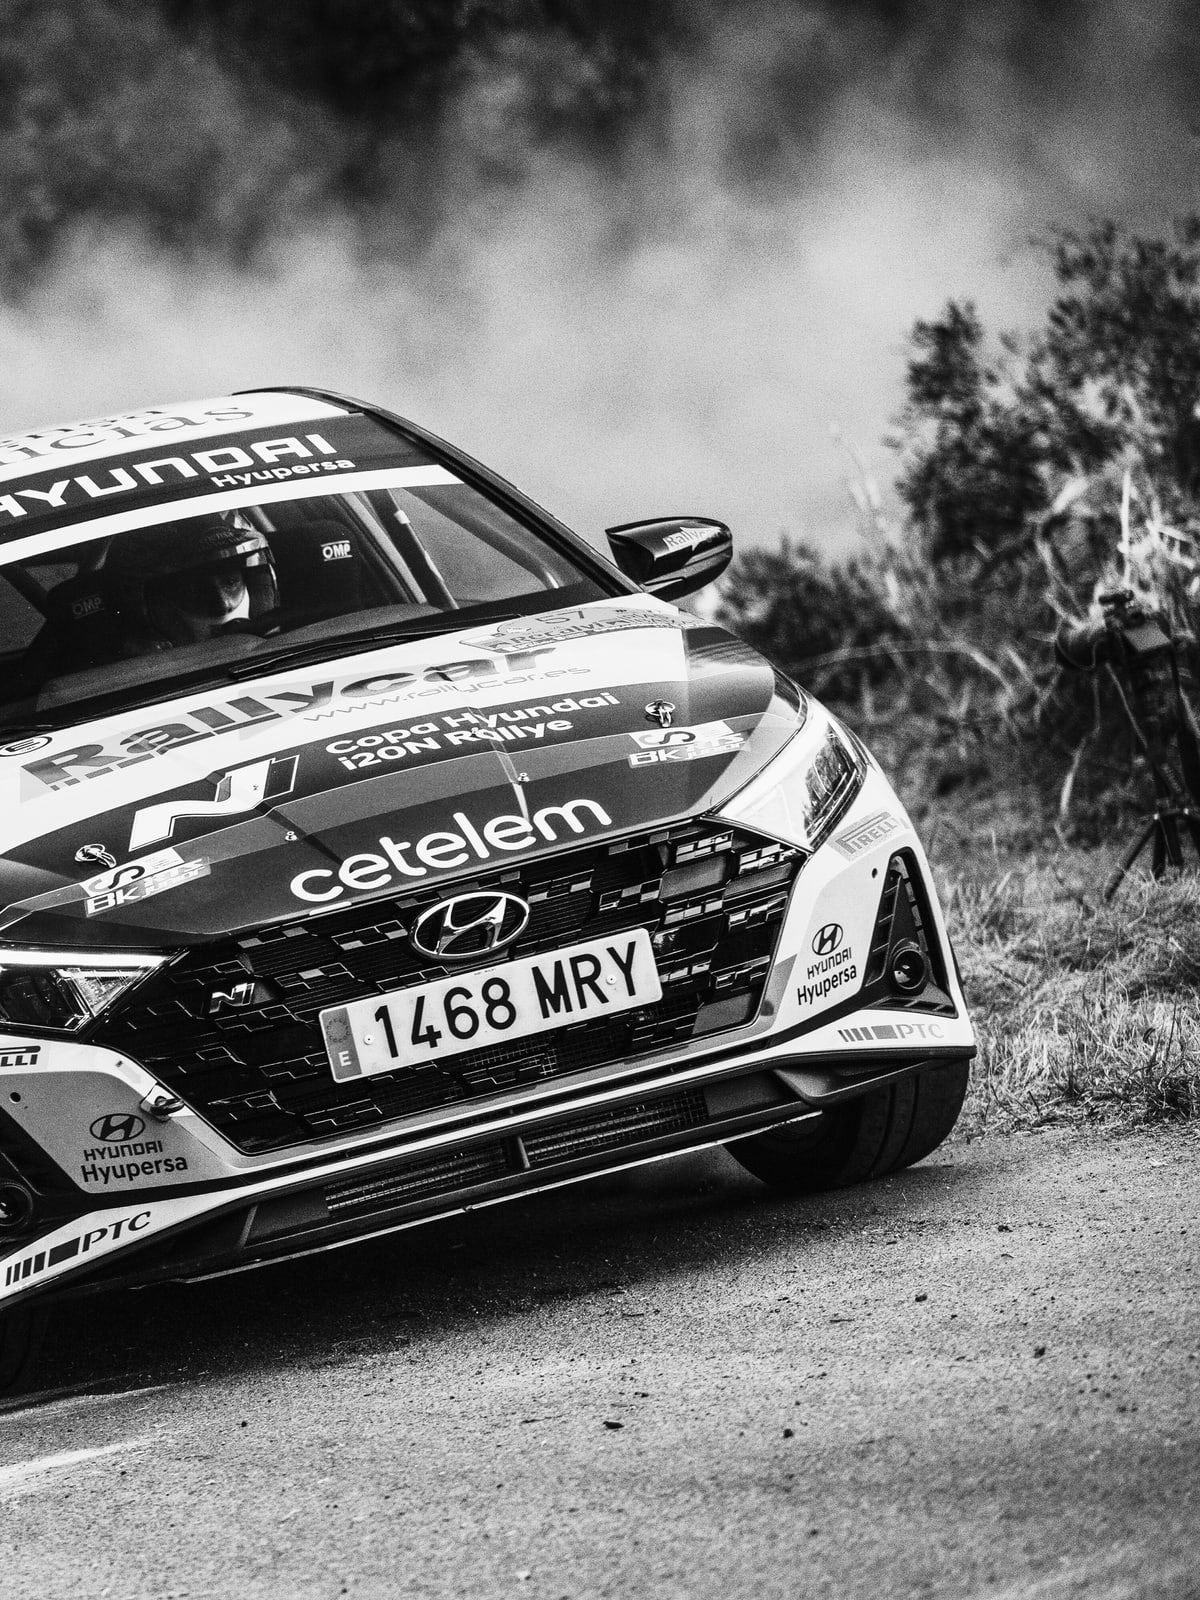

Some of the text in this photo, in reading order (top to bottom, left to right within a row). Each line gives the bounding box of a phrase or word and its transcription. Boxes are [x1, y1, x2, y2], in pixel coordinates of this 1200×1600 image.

[210, 457, 356, 489] Hyupersa
[322, 541, 351, 560] OMP
[303, 666, 592, 722] www.rallycar.es
[20, 648, 557, 786] Rallycar
[325, 692, 621, 756] Copa Hyundai
[337, 717, 575, 771] i20N Rallye
[290, 799, 613, 902] cetelem
[797, 963, 858, 1006] Hyupersa
[807, 948, 852, 980] HYUNDAI
[375, 941, 637, 1058] 1468 MRY
[895, 1022, 946, 1041] PTC
[338, 1051, 353, 1066] E
[81, 1155, 189, 1185] Hyupersa
[83, 1139, 164, 1162] HYUNDAI
[82, 1210, 152, 1253] PTC
